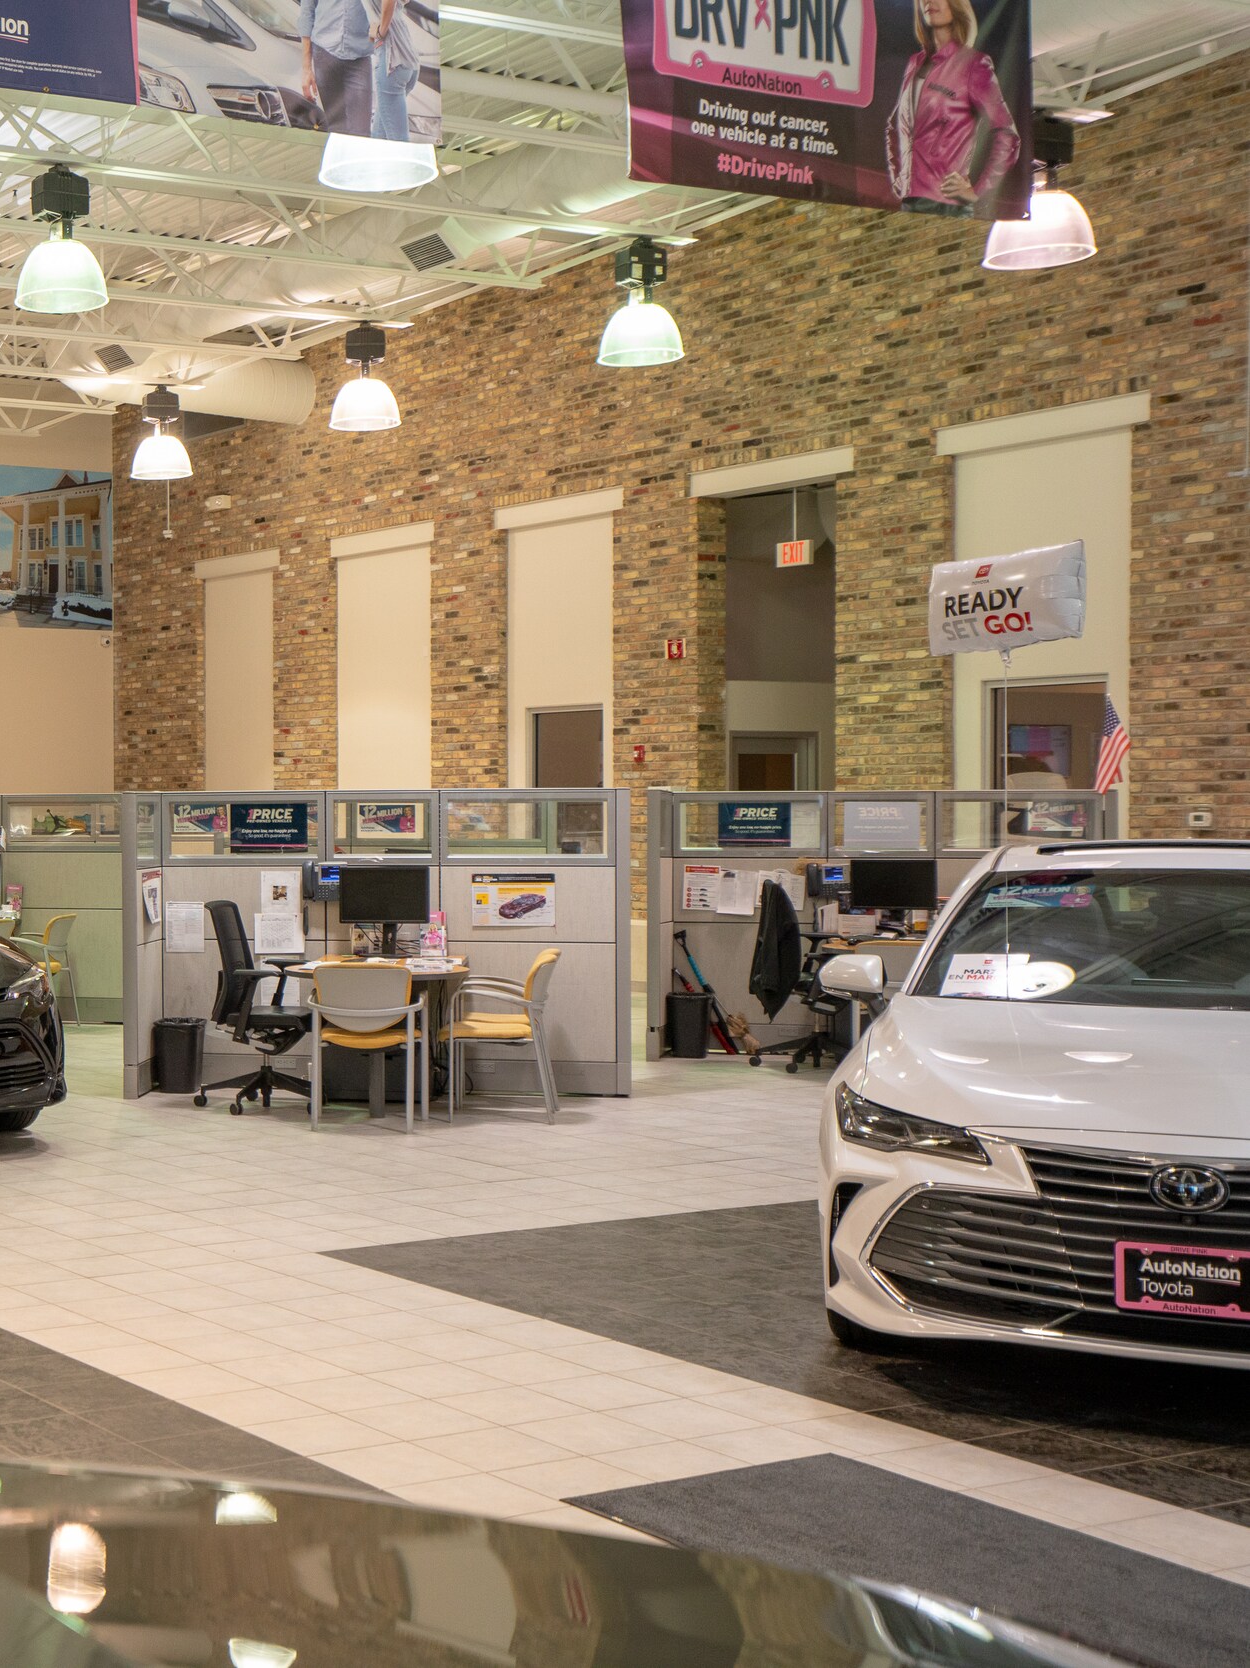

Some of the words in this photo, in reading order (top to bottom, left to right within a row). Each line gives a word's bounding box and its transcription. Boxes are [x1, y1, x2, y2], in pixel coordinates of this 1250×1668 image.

[775, 0, 850, 66] PNK
[722, 67, 802, 95] AutoNation
[699, 99, 748, 125] Driving
[752, 111, 776, 127] out
[780, 116, 829, 136] cancer,
[691, 121, 715, 137] one
[720, 125, 766, 145] vehicle
[771, 133, 785, 149] at
[789, 138, 798, 150] a
[802, 136, 839, 155] time.
[718, 153, 814, 185] #DrivePink
[783, 542, 804, 564] EXIT
[945, 586, 1024, 618] READY
[942, 618, 979, 641] SET
[984, 612, 1033, 635] GO!
[178, 804, 191, 817] 12
[191, 807, 216, 816] MILLION
[363, 805, 377, 817] 12
[377, 808, 403, 817] MILLION
[1022, 886, 1071, 894] MILLION
[1140, 1258, 1241, 1281] AutoNation
[1138, 1278, 1194, 1297] Toyota
[1163, 1303, 1216, 1315] AutoNation
